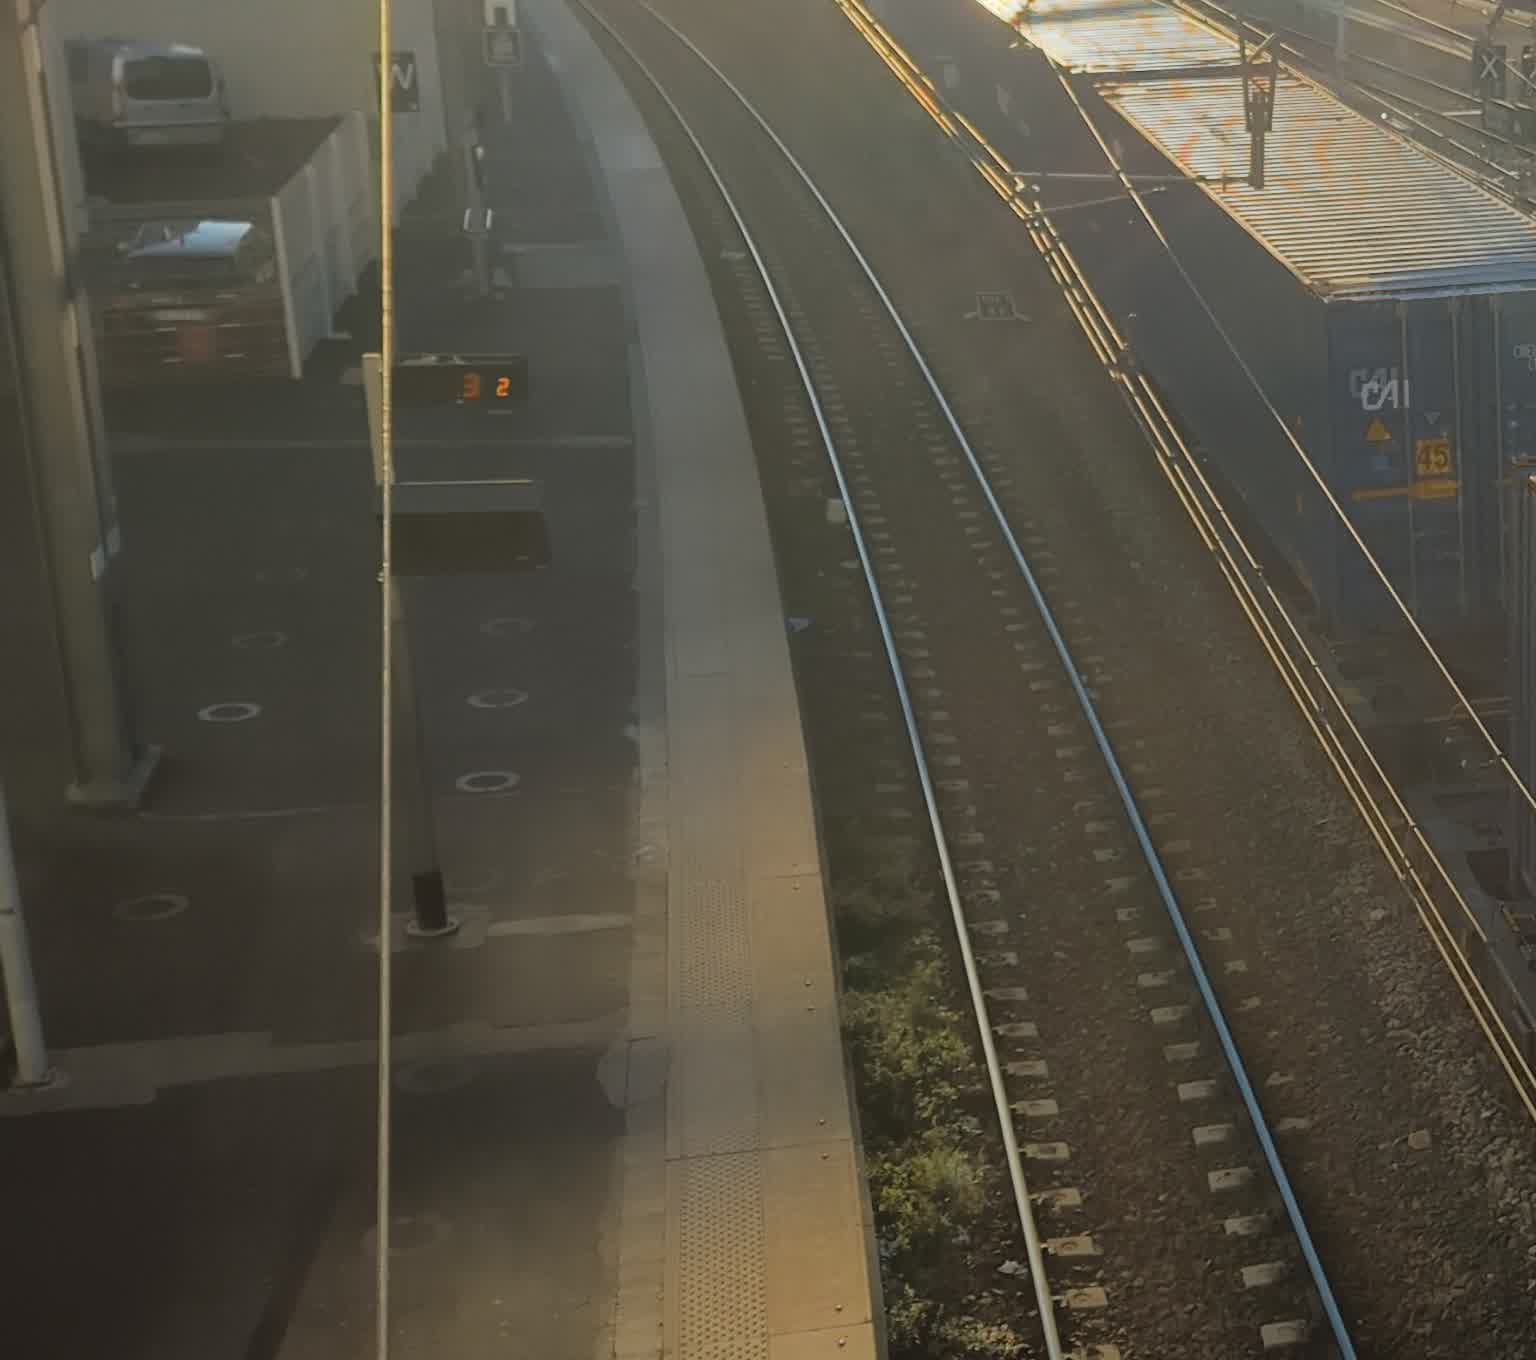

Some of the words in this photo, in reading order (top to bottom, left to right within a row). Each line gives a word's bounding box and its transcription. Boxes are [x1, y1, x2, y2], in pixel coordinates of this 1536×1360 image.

[1481, 54, 1498, 79] X
[496, 376, 512, 398] 2
[1417, 444, 1450, 472] 45
